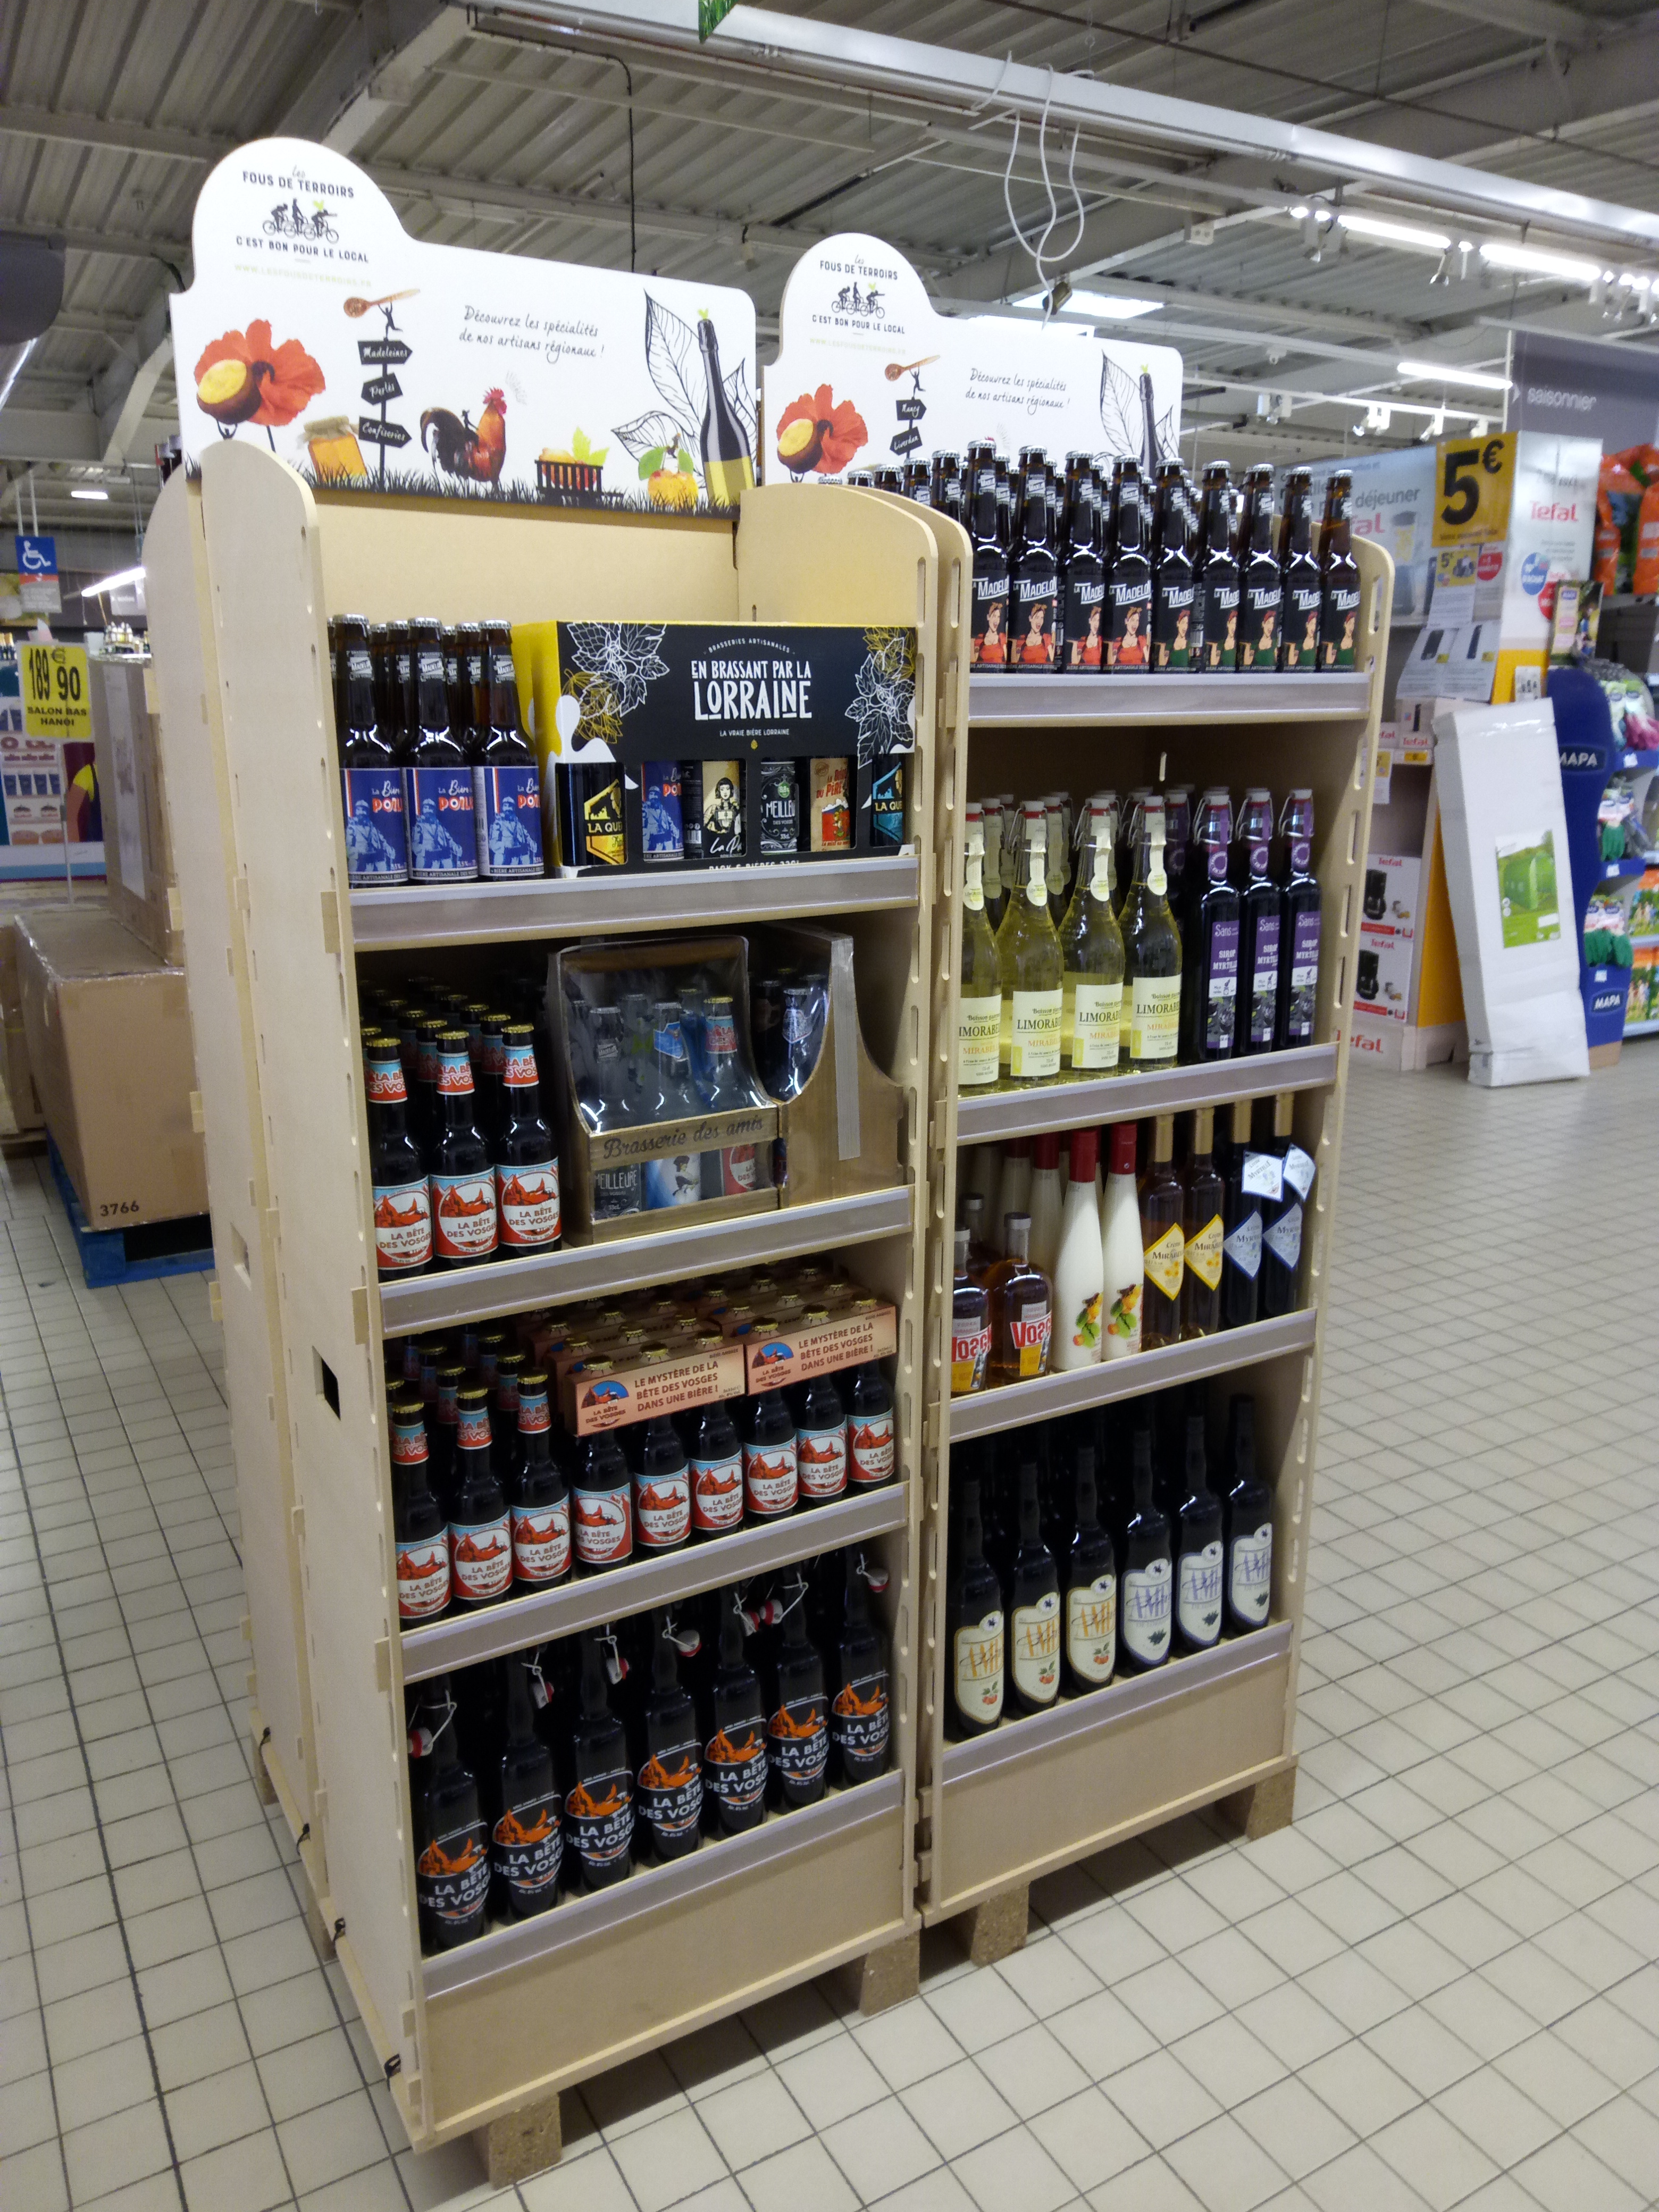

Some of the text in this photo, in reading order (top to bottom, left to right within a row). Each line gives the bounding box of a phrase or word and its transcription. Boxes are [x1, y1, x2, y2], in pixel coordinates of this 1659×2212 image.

[242, 170, 355, 198] FOUS DE TERROIRS
[269, 240, 288, 252] BON
[294, 244, 319, 256] POUR
[323, 248, 334, 258] LE
[339, 250, 368, 263] LOCAL
[820, 260, 898, 281] FOUS DE TERROIRS
[464, 304, 598, 337] Découvrez les spécialités
[835, 317, 849, 327] BON
[852, 320, 870, 330] POUR
[873, 323, 881, 331] LE
[884, 324, 905, 334] LOCAL
[459, 328, 473, 342] de
[476, 334, 493, 345] nos
[498, 335, 541, 350] artisans
[363, 346, 408, 359] Madeleines
[969, 367, 1067, 392] Découvrez les spécialités
[966, 387, 976, 399] de
[978, 391, 990, 401] nos
[993, 390, 1024, 405] artisans
[902, 404, 921, 419] Nancy
[1355, 488, 1420, 510] déjeuner
[1529, 500, 1579, 522] Tefal
[1020, 575, 1058, 600] MADELON
[1116, 580, 1152, 603] MADELON
[708, 638, 790, 653] BRASSERIES ARTISANALES
[29, 648, 51, 701] 189
[56, 666, 81, 701] 90
[691, 660, 812, 679] EN BRASSANT PAR LA
[693, 680, 812, 720] LORRAINE
[875, 802, 887, 811] LA
[587, 823, 602, 834] LA
[1594, 993, 1621, 1010] MAPA
[1350, 1034, 1385, 1054] efal
[603, 1115, 764, 1160] Brasserie des amis
[594, 1169, 638, 1189] MEILLEURE
[99, 1200, 140, 1217] 3766
[520, 1206, 552, 1218] LA BÊTE
[473, 1217, 490, 1227] BÊTE
[509, 1211, 559, 1226] DES VOSGES
[391, 1227, 425, 1241] LA BÊTE
[447, 1229, 464, 1238] DES
[379, 1239, 398, 1249] DES
[798, 1322, 874, 1349] LE MYSTÈRE DE LA
[800, 1333, 873, 1360] BÊTE DES VOSGES
[801, 1359, 825, 1371] DANS
[826, 1352, 843, 1364] UNE
[845, 1345, 869, 1359] BIÈRE
[634, 1360, 718, 1388] LE MYSTÈRE DE LA
[636, 1372, 718, 1400] BÊTE DES VOSGES
[638, 1399, 665, 1412] DANS
[666, 1394, 685, 1405] UNE
[688, 1386, 713, 1399] BIÈRE
[544, 1543, 562, 1554] BÊTE
[653, 1797, 670, 1808] LA
[639, 1807, 664, 1821] DES
[580, 1825, 599, 1837] LA
[566, 1834, 590, 1849] DES
